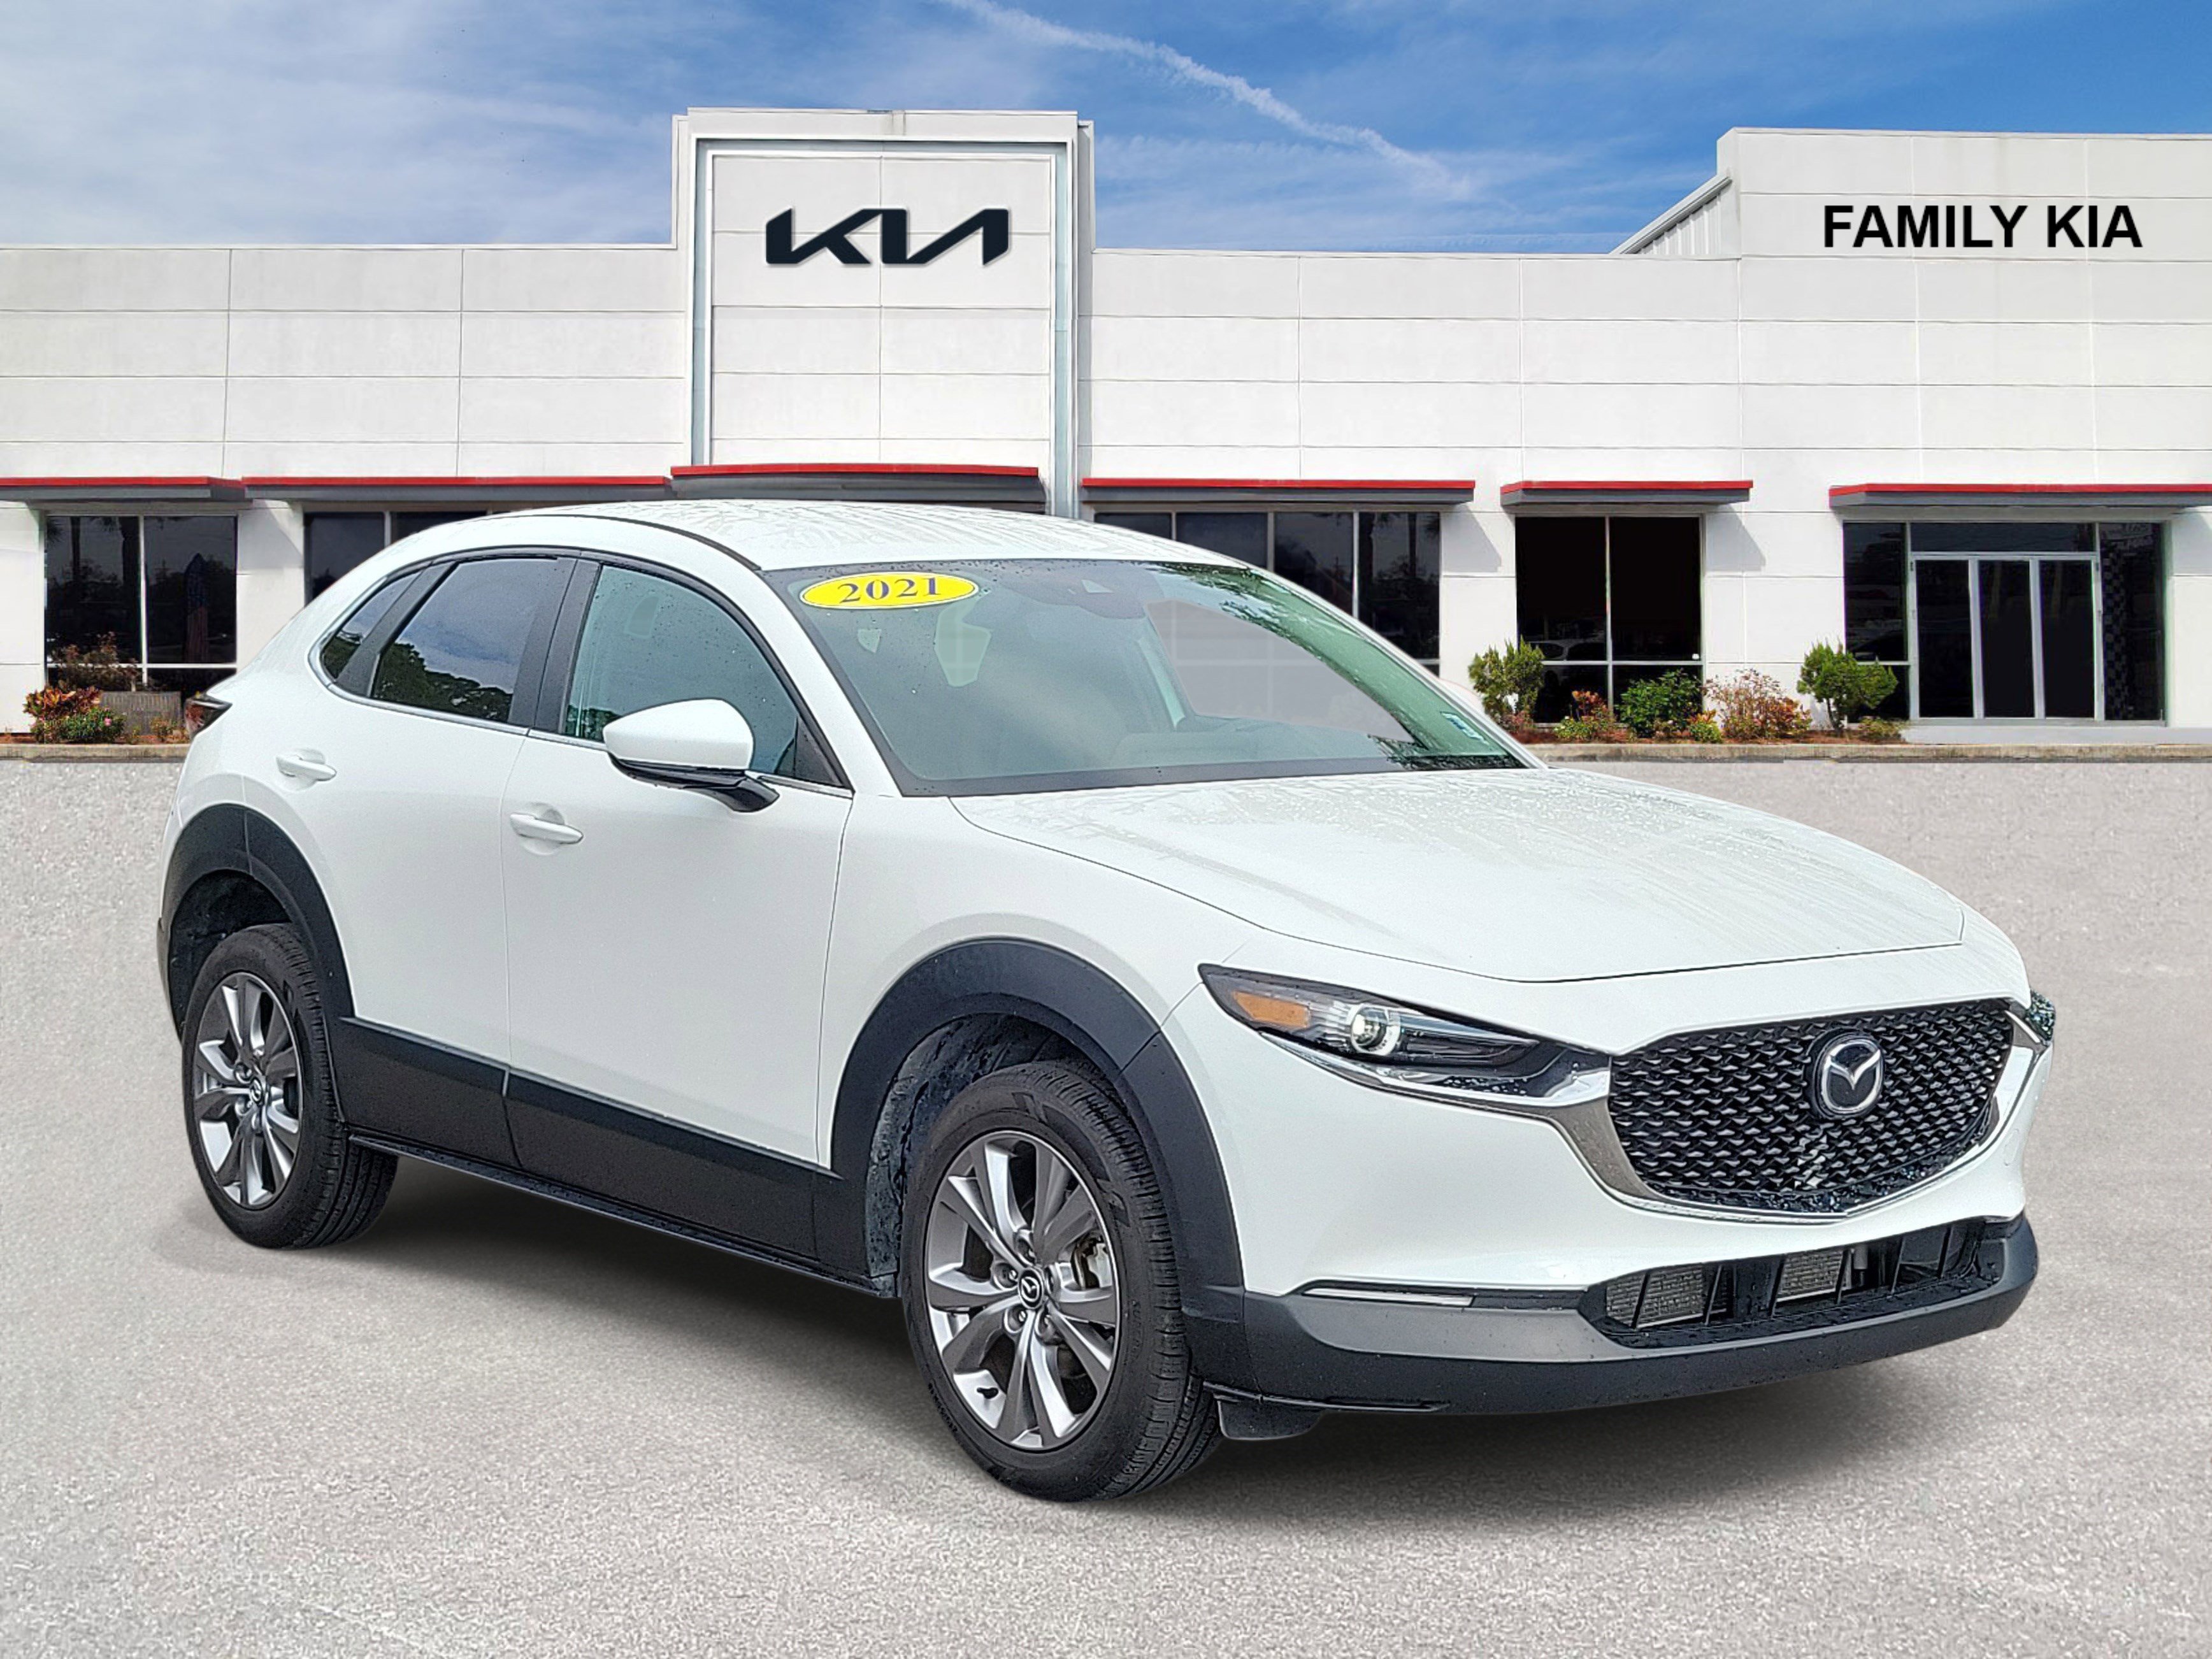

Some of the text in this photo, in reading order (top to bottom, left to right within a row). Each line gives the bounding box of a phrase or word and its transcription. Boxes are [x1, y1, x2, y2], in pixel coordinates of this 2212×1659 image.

[766, 208, 1009, 266] KIA
[1824, 205, 2143, 248] FAMILY KIA
[837, 577, 941, 604] 2021
